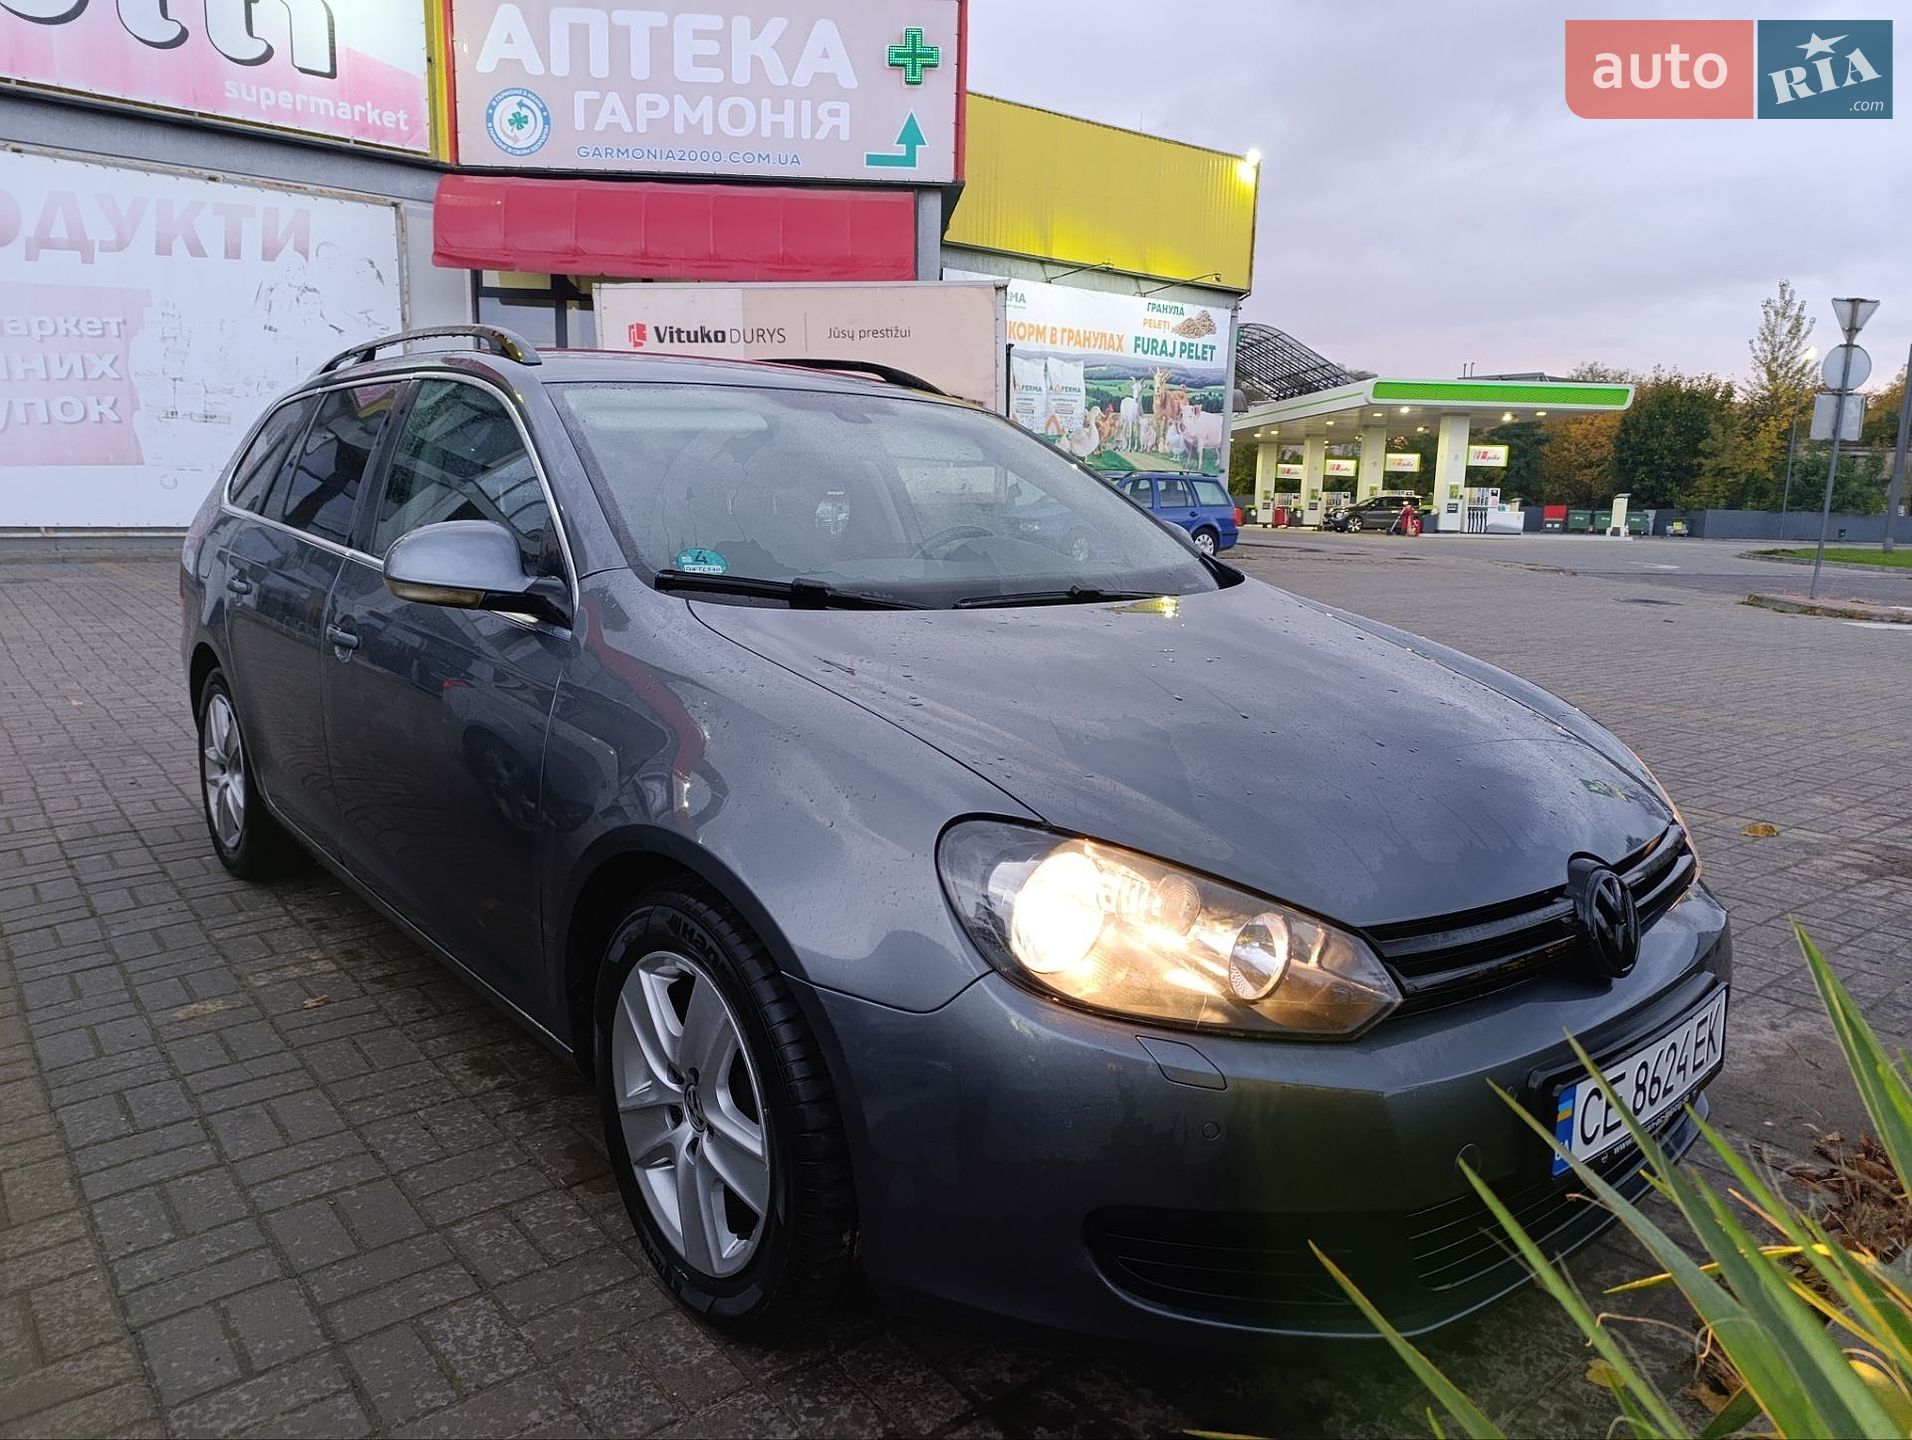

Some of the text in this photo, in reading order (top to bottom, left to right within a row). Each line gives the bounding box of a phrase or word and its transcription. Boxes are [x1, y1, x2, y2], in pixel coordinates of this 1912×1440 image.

[476, 3, 858, 89] АПТЕКА
[224, 81, 409, 131] supermarket
[574, 90, 850, 140] ГАРМОНІЯ
[576, 145, 801, 166] GARMONIA2000.COM.UA
[1147, 302, 1185, 317] ГРАНУЛА
[858, 326, 911, 342] prestižui
[1008, 320, 1125, 352] КОРМ В ГРАНУЛАХ
[1134, 336, 1216, 362] FURAJ PELET
[1632, 1029, 1691, 1117] 8624
[1692, 1003, 1721, 1074] EK
